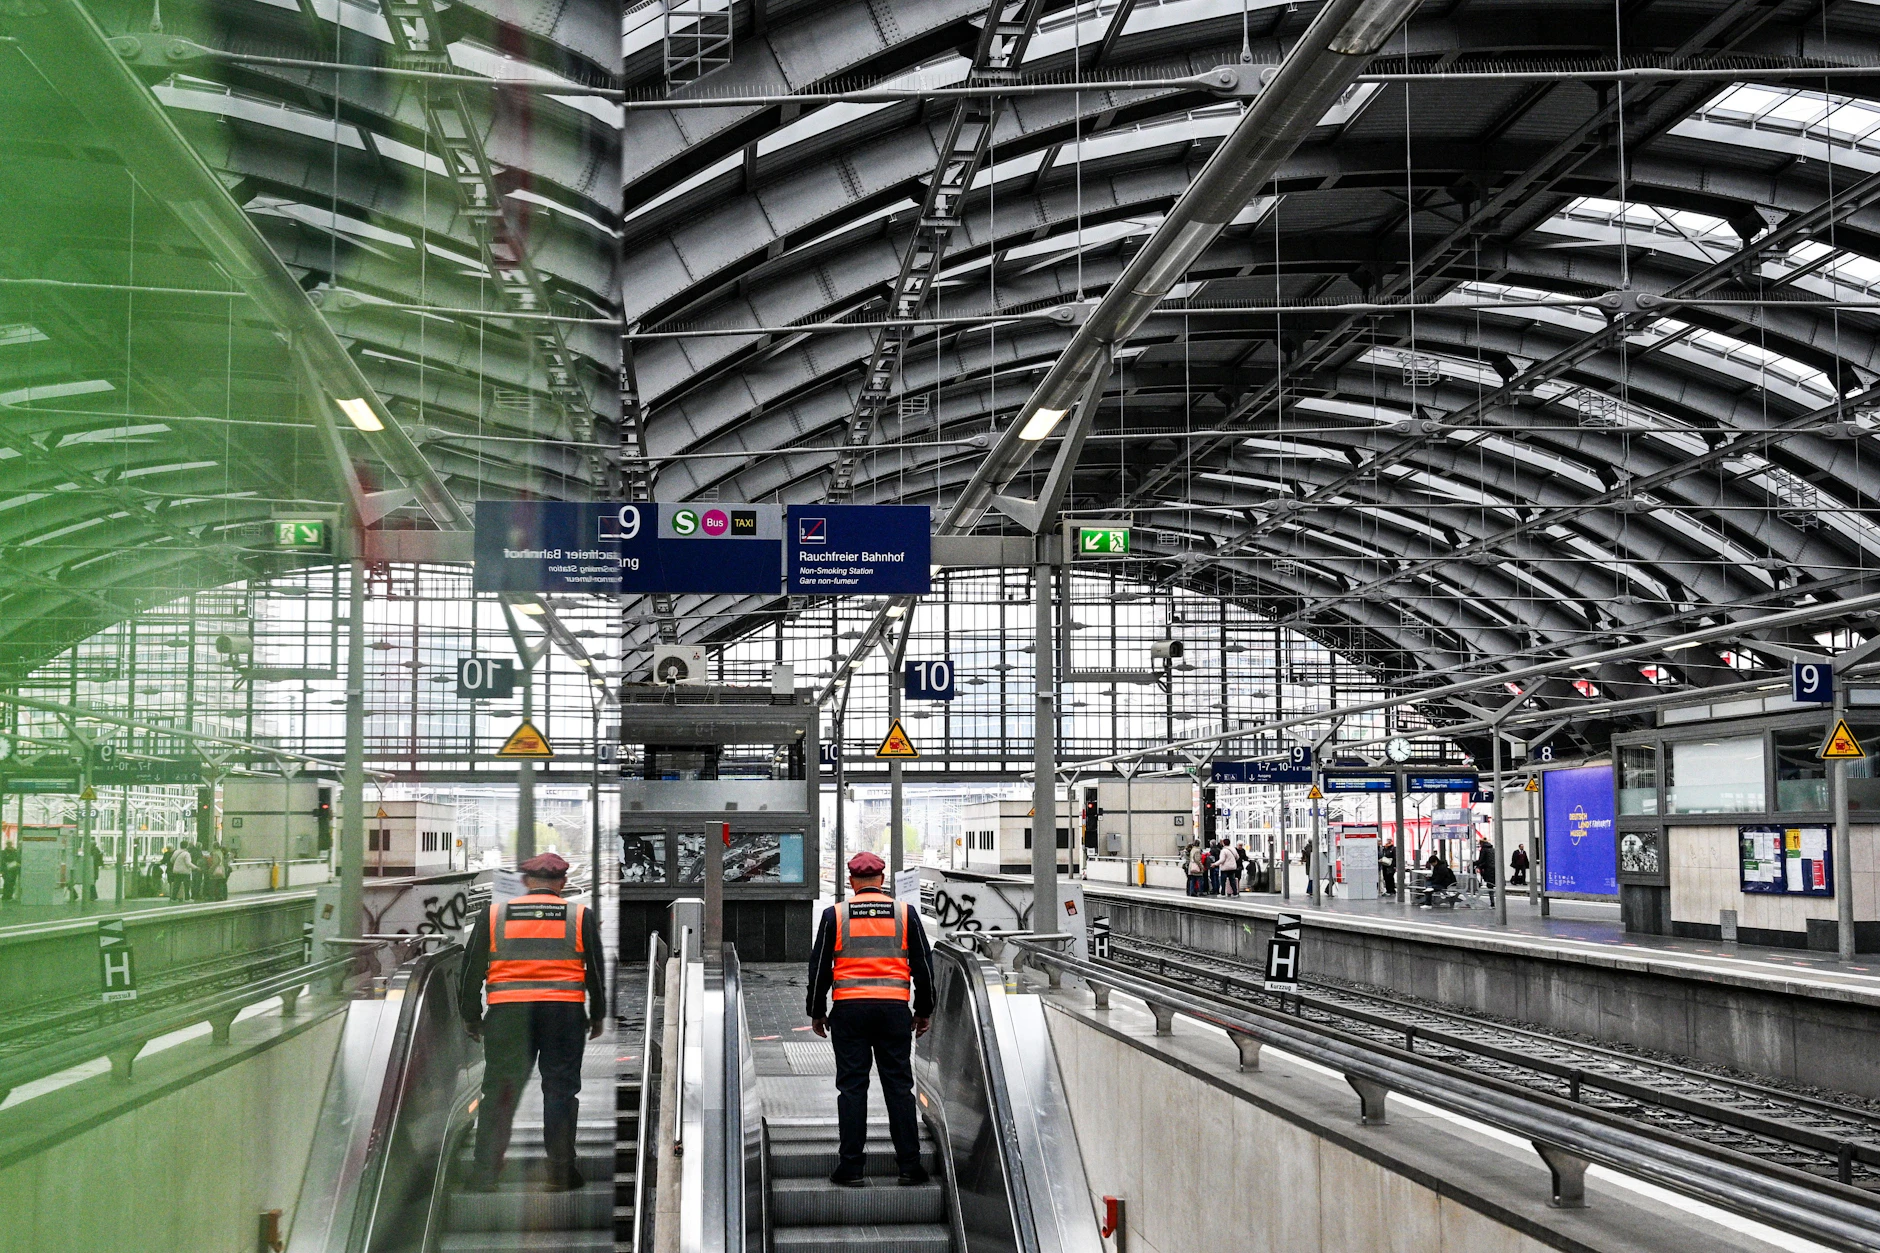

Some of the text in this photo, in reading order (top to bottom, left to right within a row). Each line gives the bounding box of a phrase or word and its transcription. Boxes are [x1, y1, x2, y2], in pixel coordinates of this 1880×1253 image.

[618, 505, 641, 539] 9
[675, 511, 754, 534] S Bus TAXI
[799, 551, 905, 562] Rauchfreier Bahnhof
[799, 567, 874, 576] Non-Smoking Station
[799, 577, 859, 585] Gare non-fumeur
[914, 661, 950, 691] 10
[1801, 664, 1819, 694] 9
[821, 744, 838, 760] 10
[1293, 747, 1304, 763] 9
[1541, 746, 1552, 762] 8
[1257, 762, 1270, 771] 1-7
[1095, 937, 1108, 957] H
[1270, 944, 1296, 978] H
[1270, 983, 1292, 991] Kurzzug
